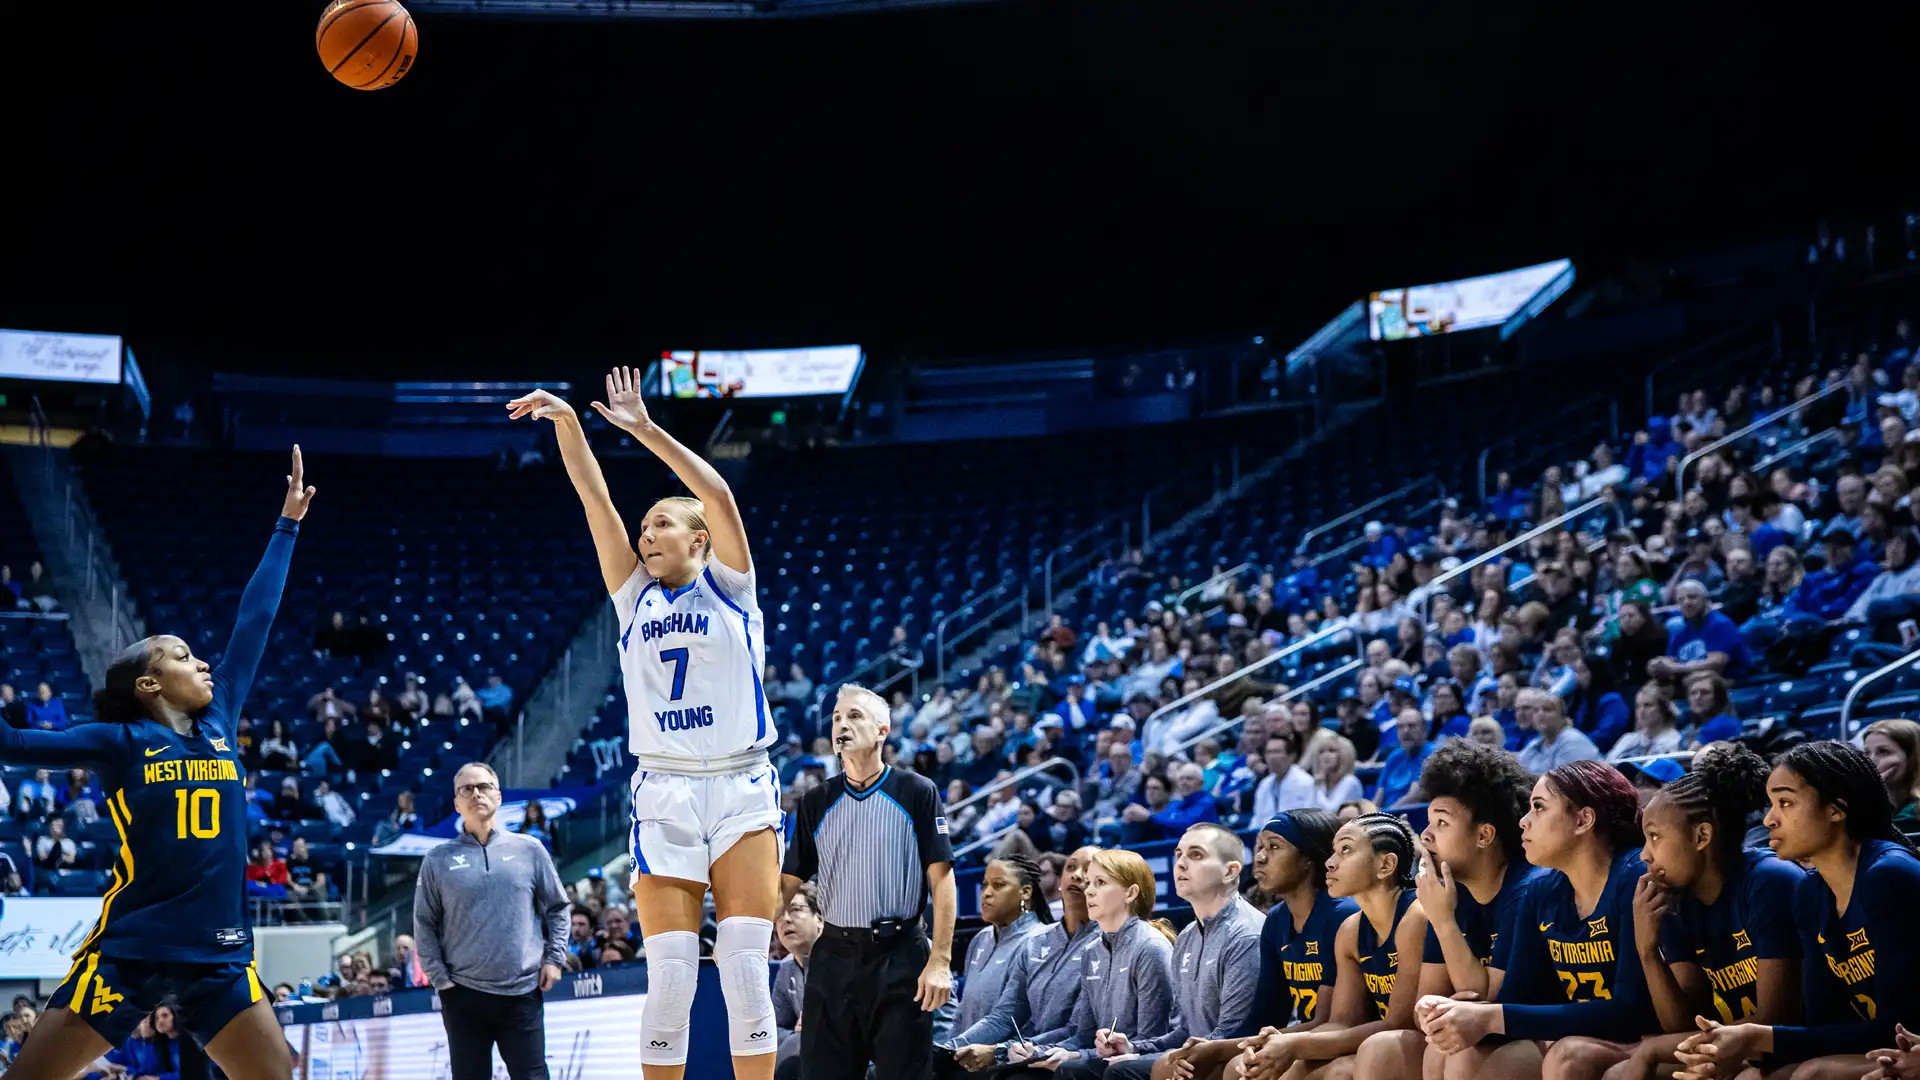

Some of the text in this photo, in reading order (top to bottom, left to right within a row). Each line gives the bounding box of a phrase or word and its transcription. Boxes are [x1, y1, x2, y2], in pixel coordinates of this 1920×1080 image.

[641, 612, 709, 643] BRGHAM
[659, 647, 690, 701] 7
[654, 705, 714, 732] YOUNG
[143, 760, 182, 785] WEST
[175, 788, 221, 839] 10
[1548, 939, 1615, 963] EST VIRGINIA
[1712, 956, 1758, 992] VIRGINI
